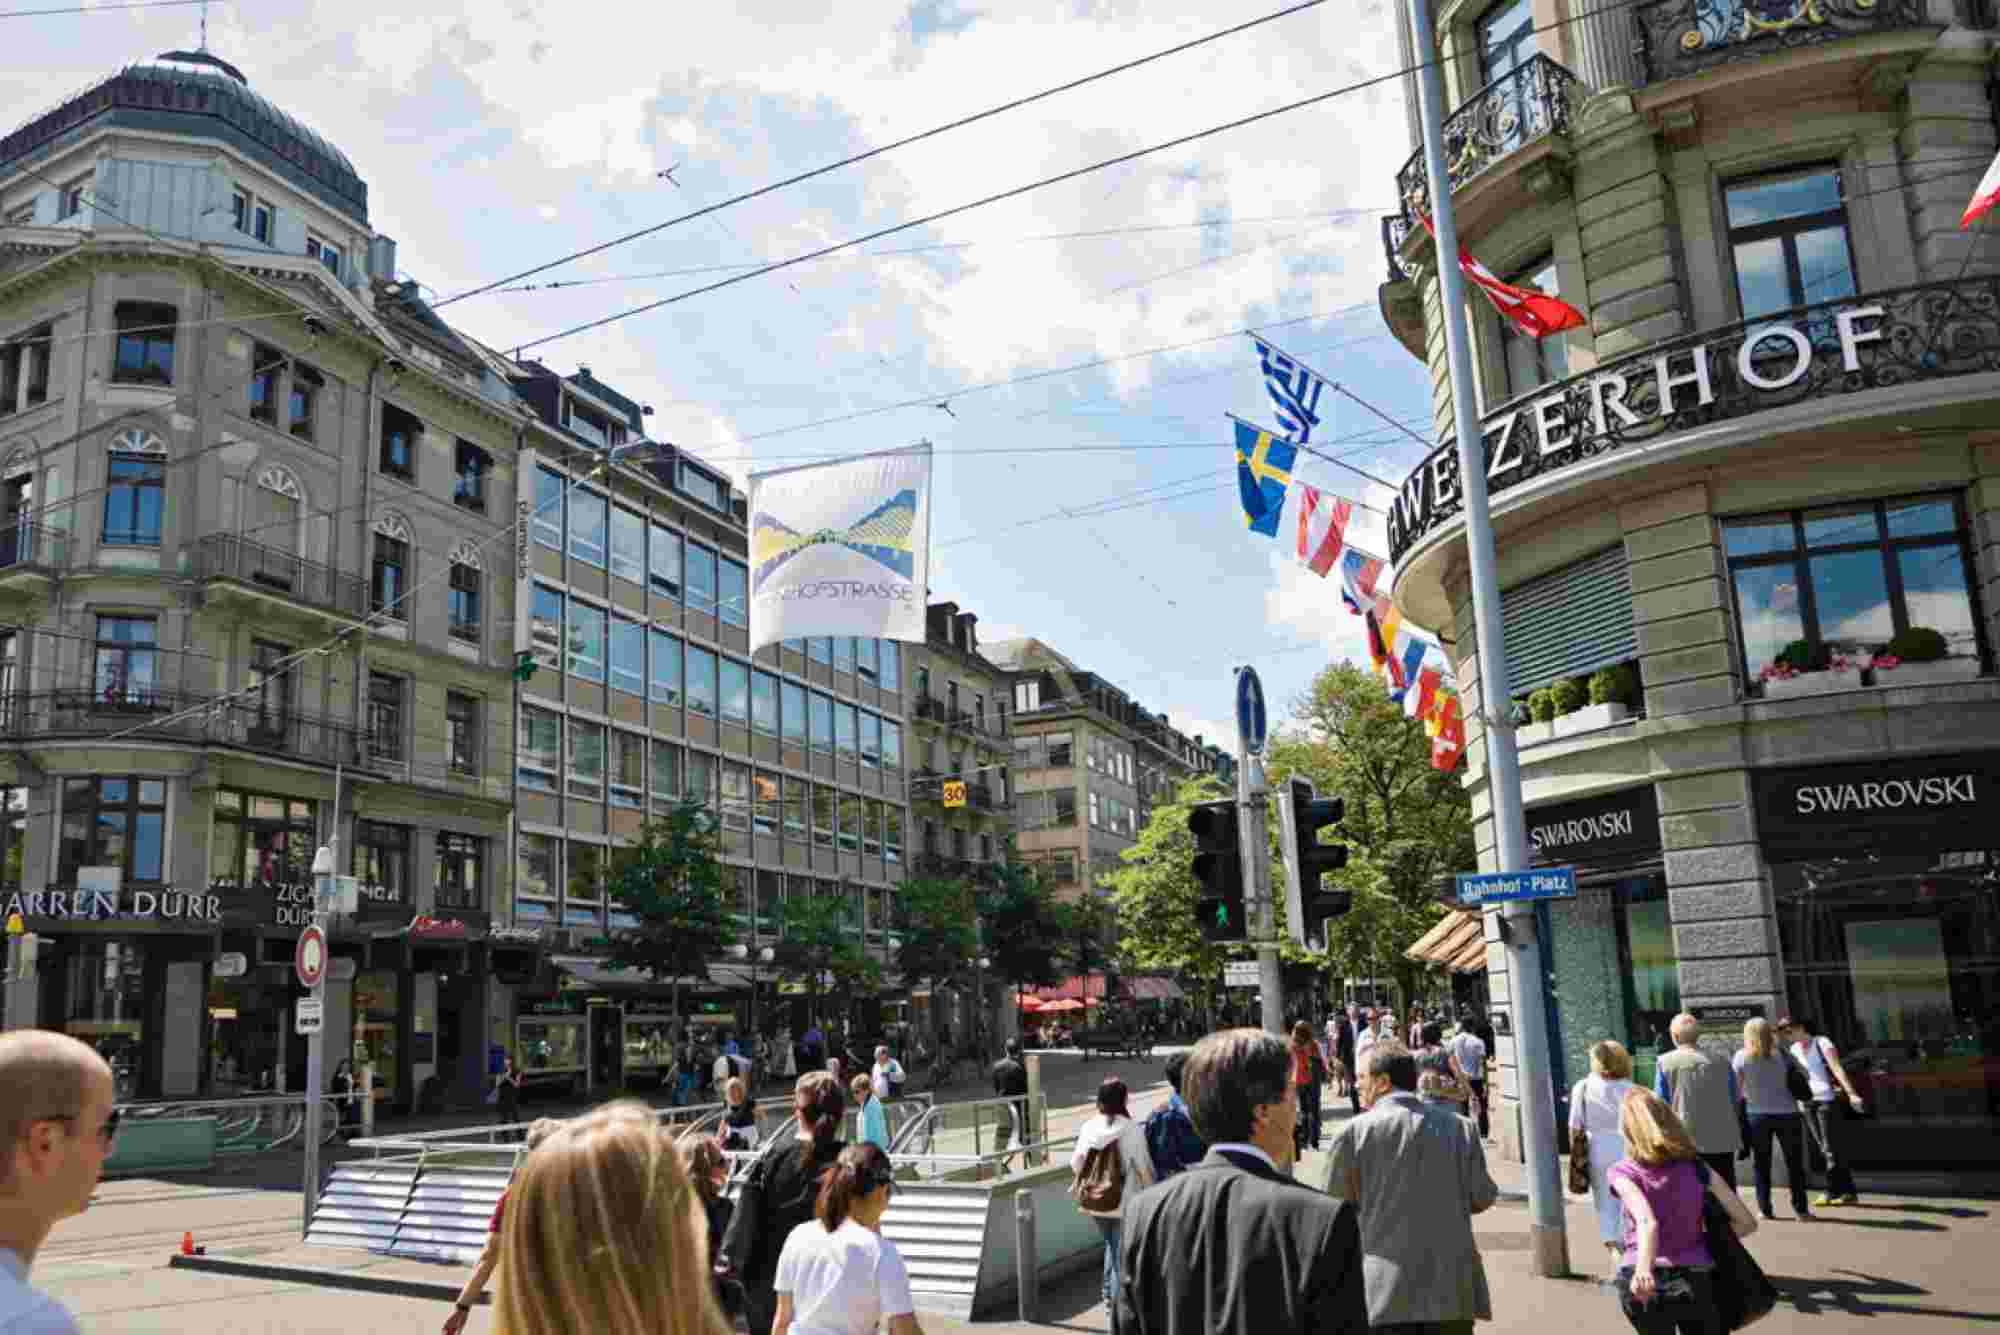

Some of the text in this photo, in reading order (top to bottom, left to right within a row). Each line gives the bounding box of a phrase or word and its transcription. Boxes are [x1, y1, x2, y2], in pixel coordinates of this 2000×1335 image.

[1388, 305, 1887, 558] HWEZERHOF
[1796, 773, 1976, 814] SWAROVSKI
[1531, 809, 1633, 850] SWAROVSKI
[0, 886, 225, 921] ARREN DÜRR
[276, 903, 314, 925] DÜR
